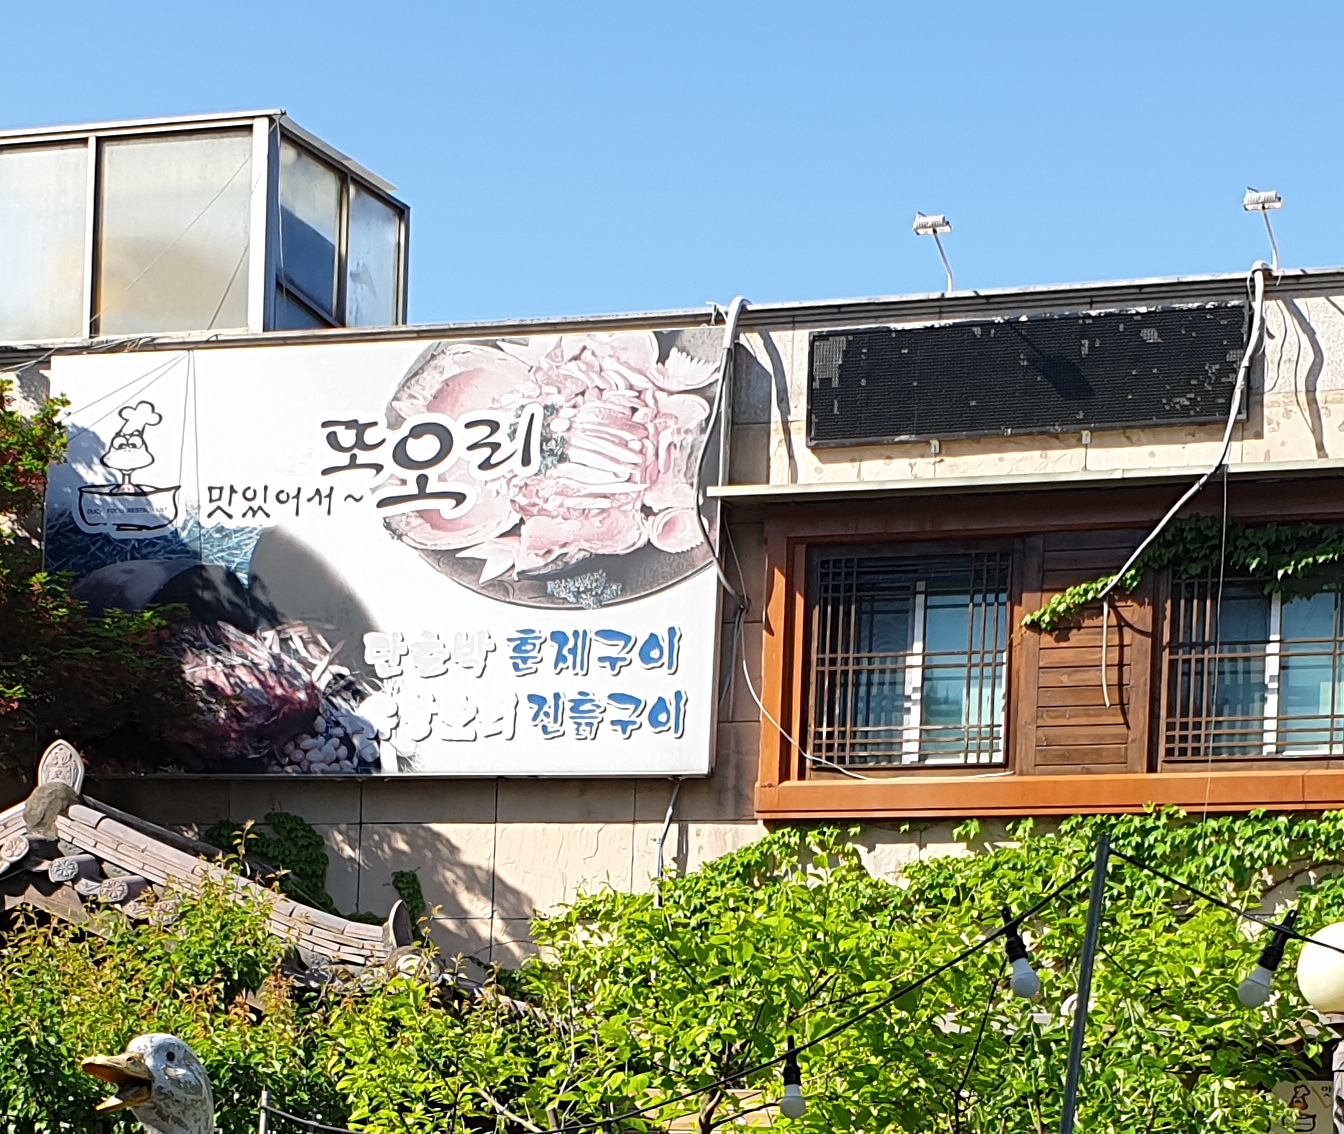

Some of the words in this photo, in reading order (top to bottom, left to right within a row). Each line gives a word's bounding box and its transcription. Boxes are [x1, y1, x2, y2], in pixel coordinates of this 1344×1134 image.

[320, 411, 535, 511] 또오리
[362, 630, 496, 679] 단호박
[506, 625, 682, 677] 훈제구이
[526, 689, 689, 740] 진흙구이
